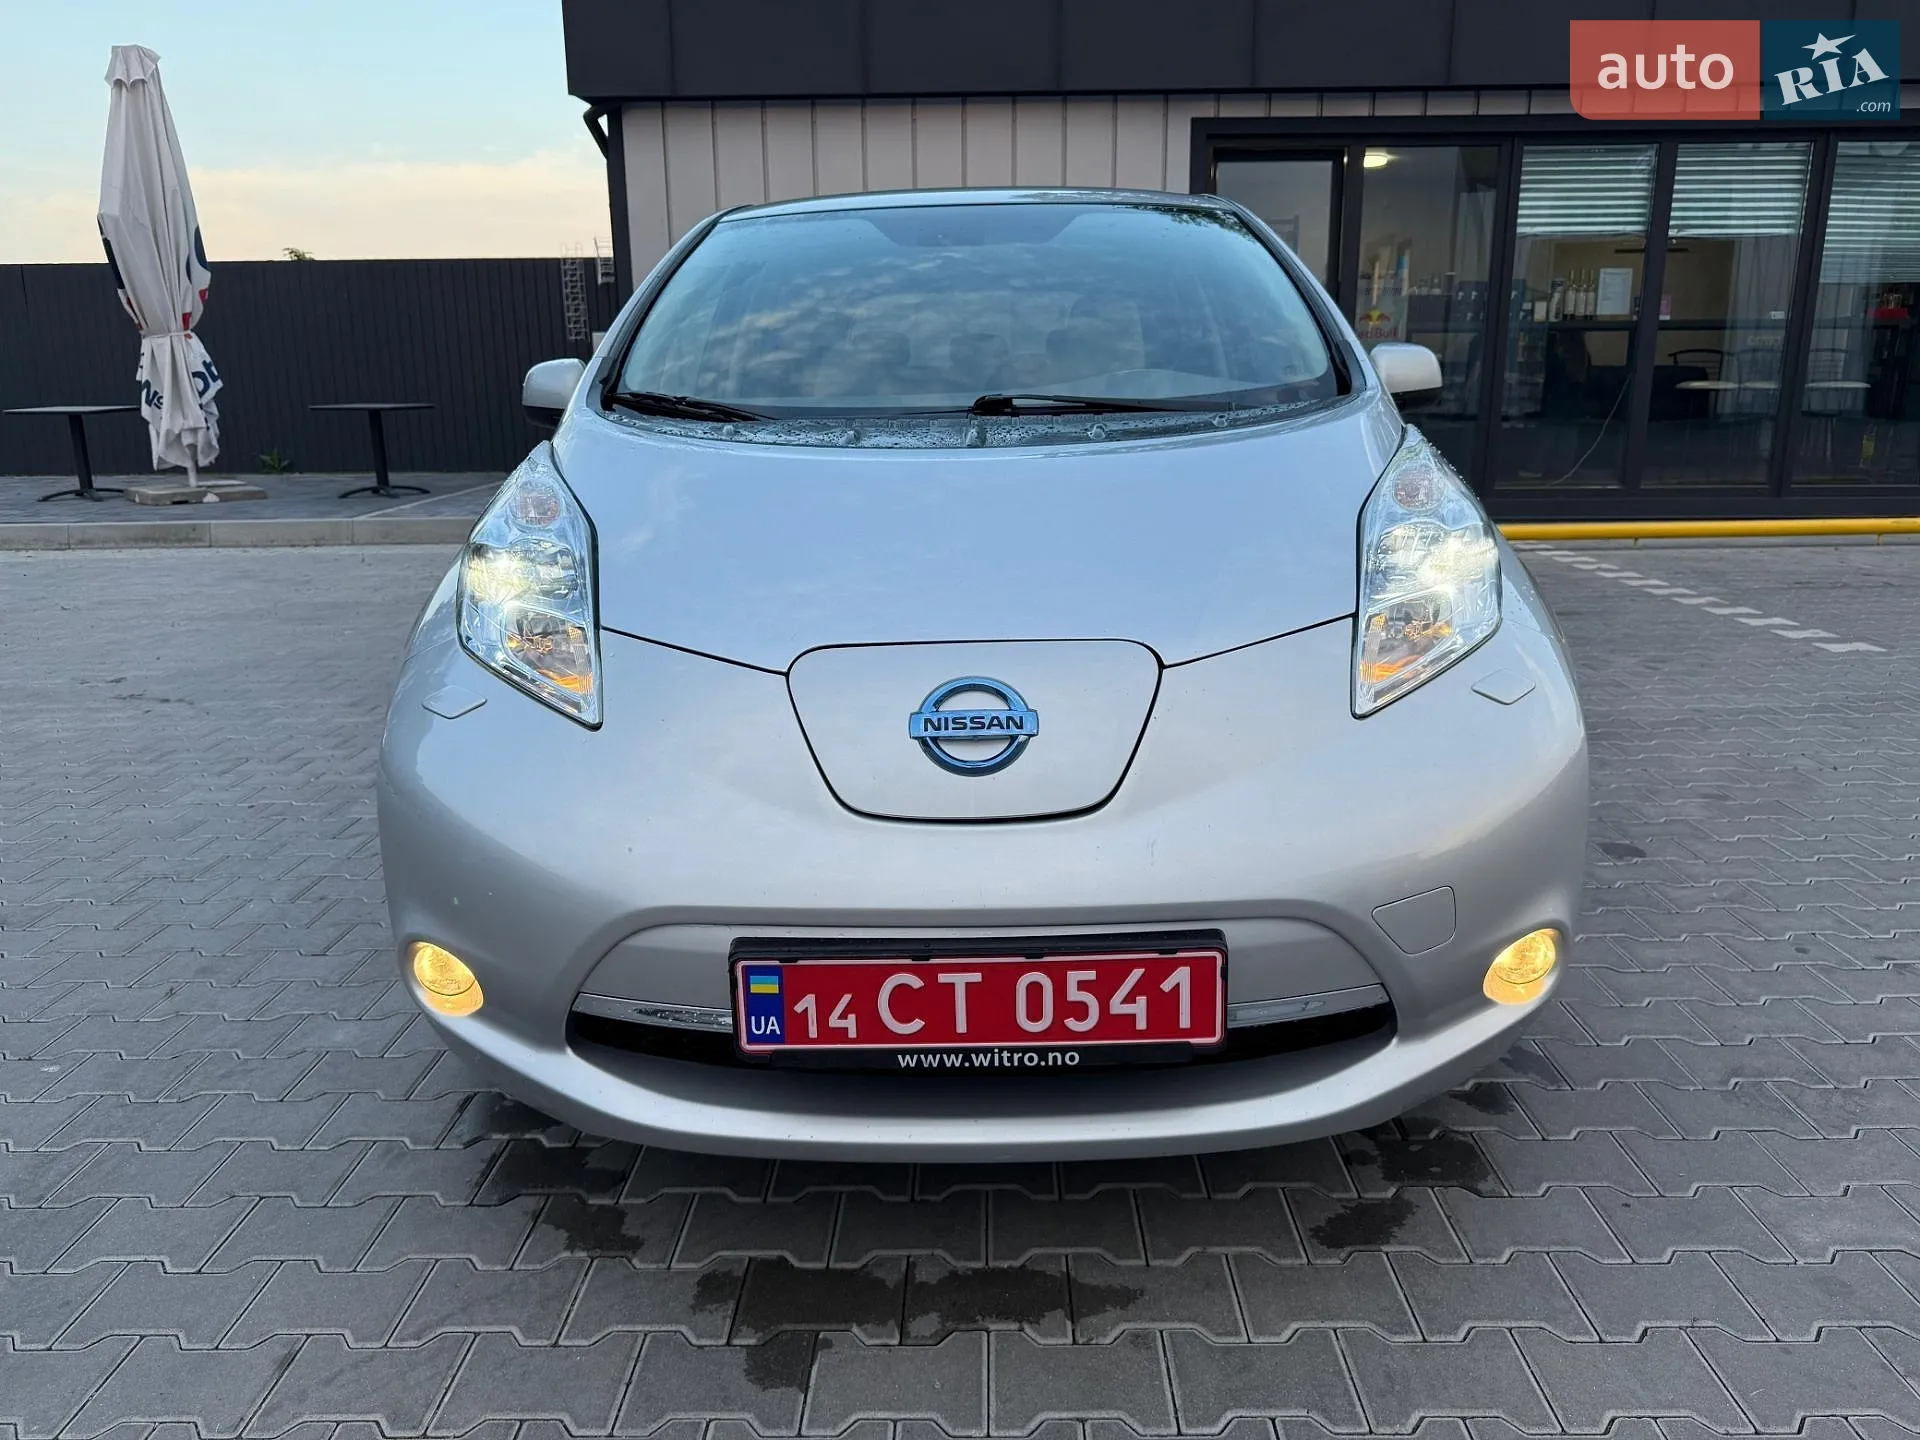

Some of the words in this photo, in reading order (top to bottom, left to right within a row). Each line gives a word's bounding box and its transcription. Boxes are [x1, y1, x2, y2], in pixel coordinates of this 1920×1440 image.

[923, 715, 1024, 732] NISSAN
[793, 994, 857, 1039] 14
[878, 972, 982, 1035] CT
[1015, 966, 1191, 1033] 0541
[751, 1016, 781, 1035] UA
[897, 1048, 1080, 1068] www.witro.no
